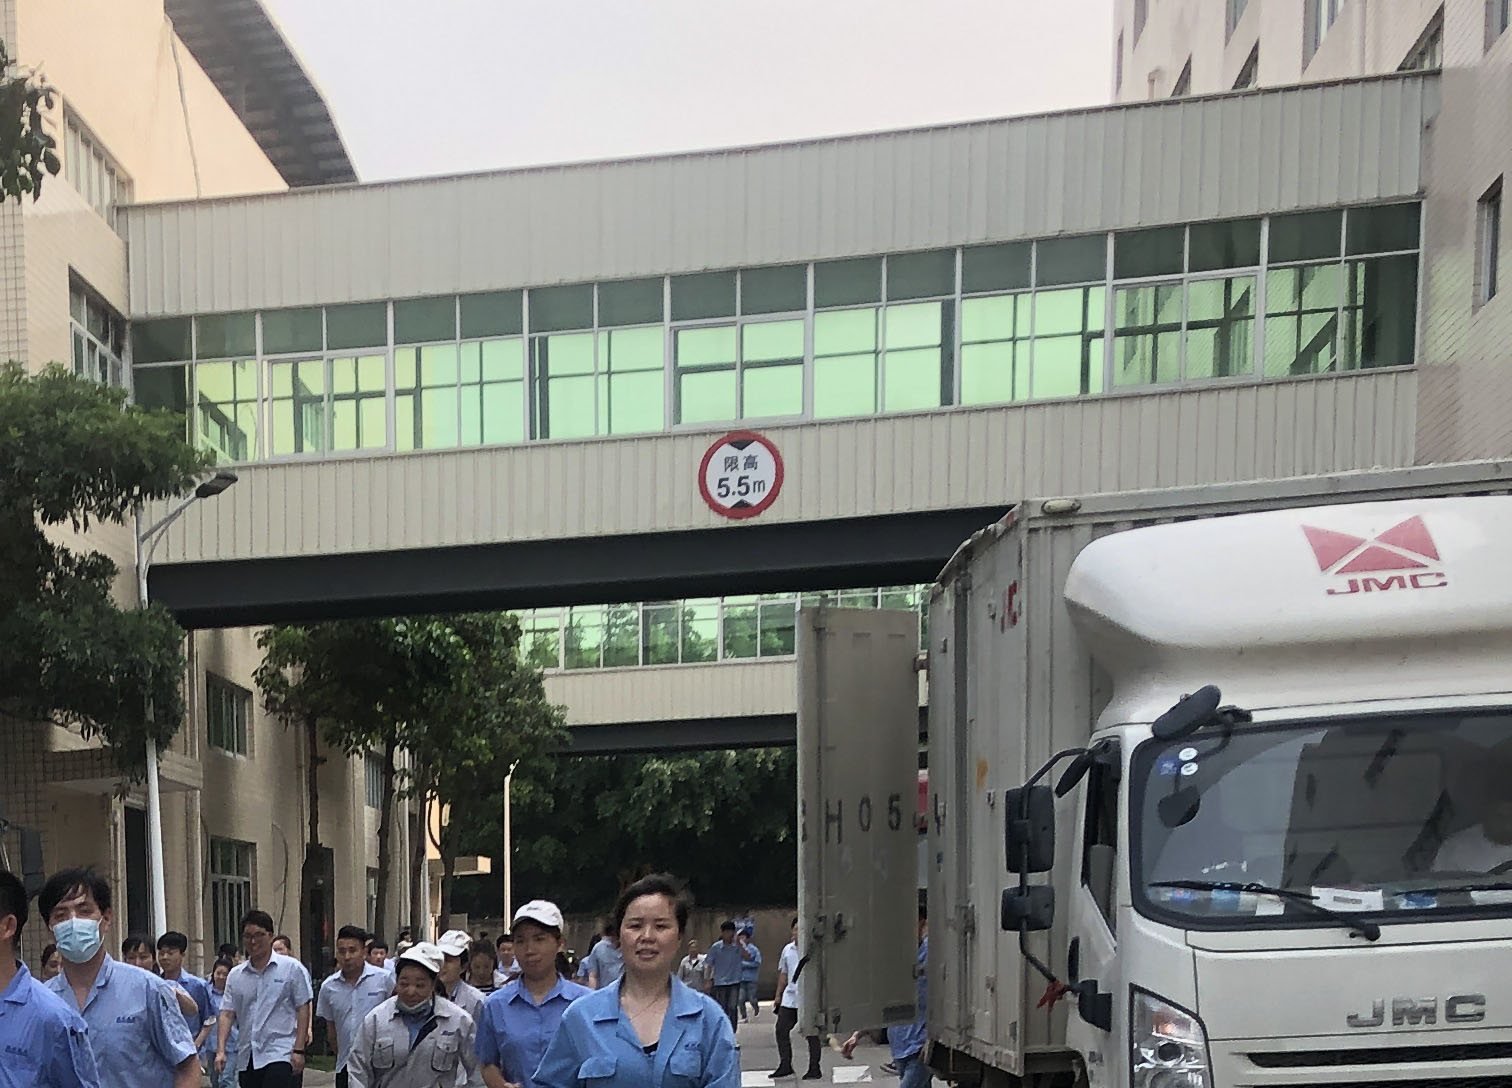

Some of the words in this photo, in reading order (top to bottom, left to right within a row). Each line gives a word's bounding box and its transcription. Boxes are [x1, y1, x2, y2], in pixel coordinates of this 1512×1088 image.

[724, 454, 759, 472] 限高
[717, 475, 766, 498] 5.5m
[1326, 572, 1448, 595] JMC
[1346, 994, 1486, 1028] JMC
